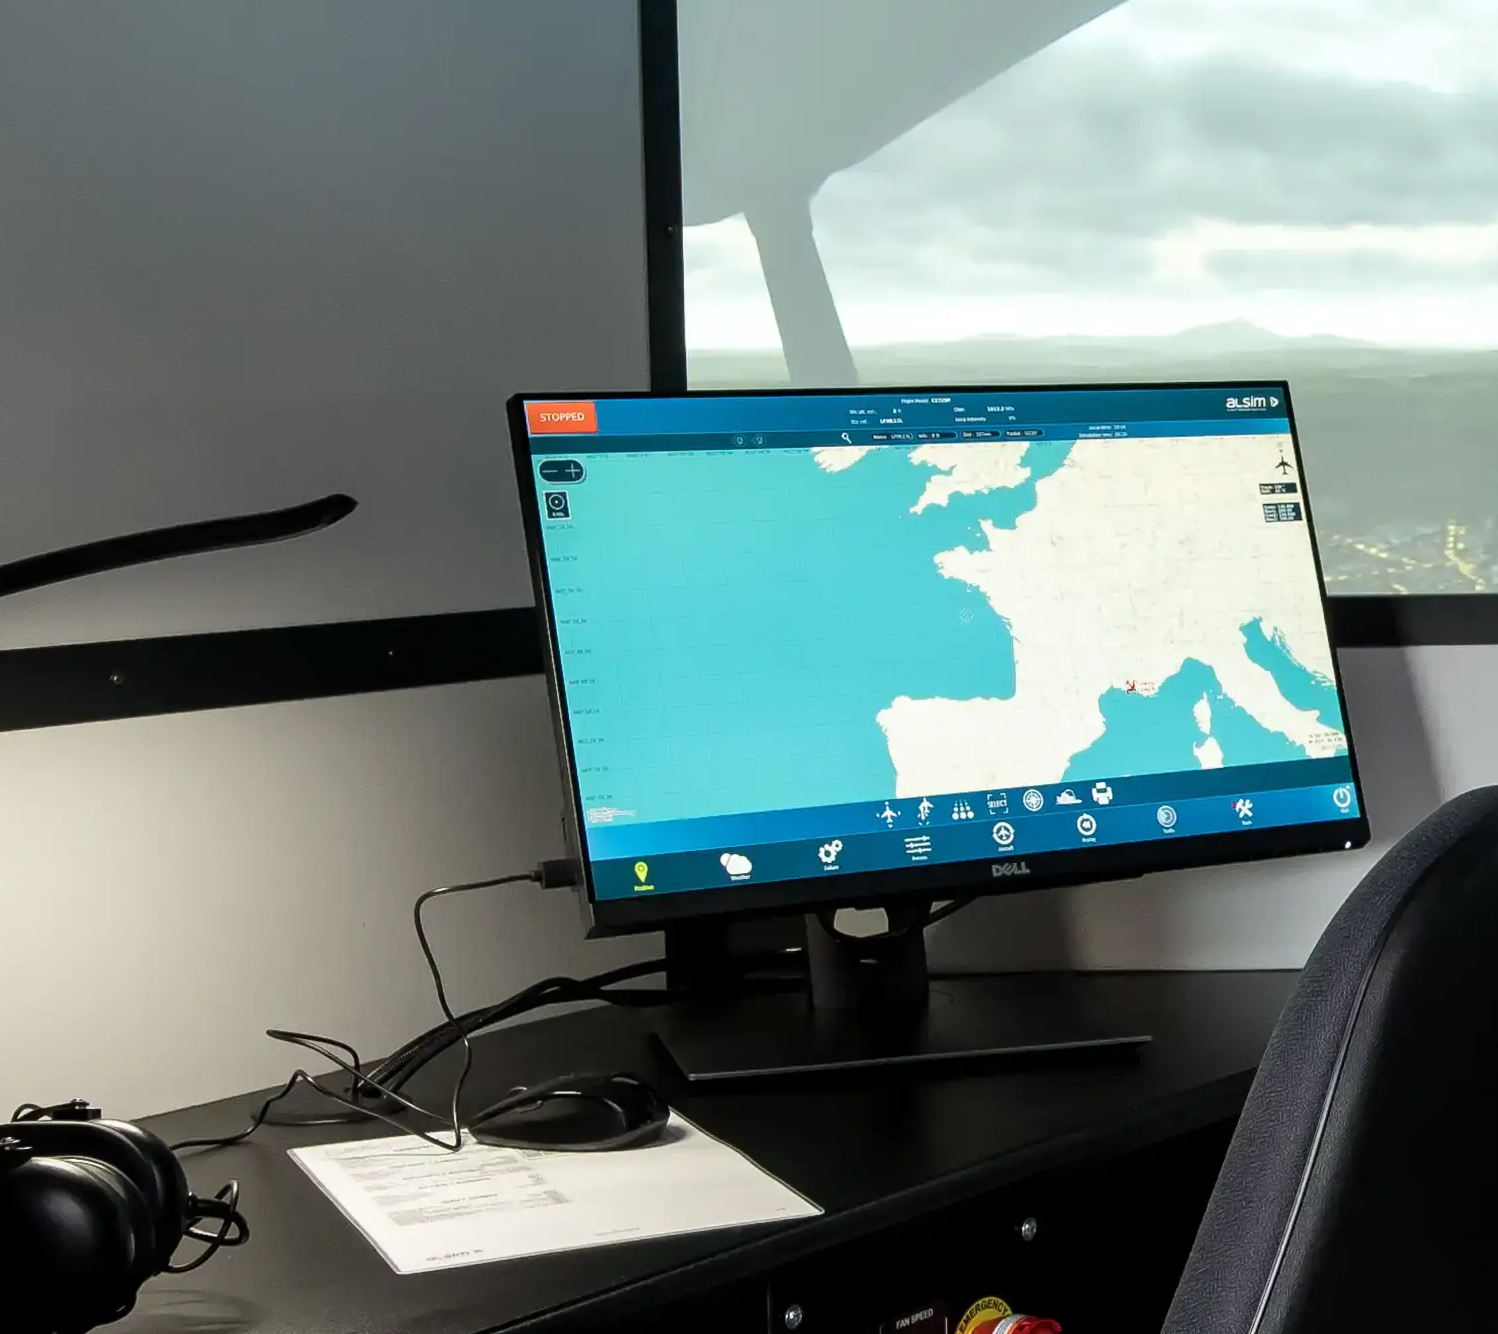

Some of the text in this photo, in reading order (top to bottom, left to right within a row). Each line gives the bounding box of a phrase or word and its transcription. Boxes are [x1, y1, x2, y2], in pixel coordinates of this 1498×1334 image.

[539, 411, 585, 423] STOPPED
[987, 799, 1007, 808] SELECT
[990, 861, 1031, 877] DELL
[895, 1308, 934, 1330] FAN SPEED
[958, 1297, 1009, 1334] EMERGENCY
